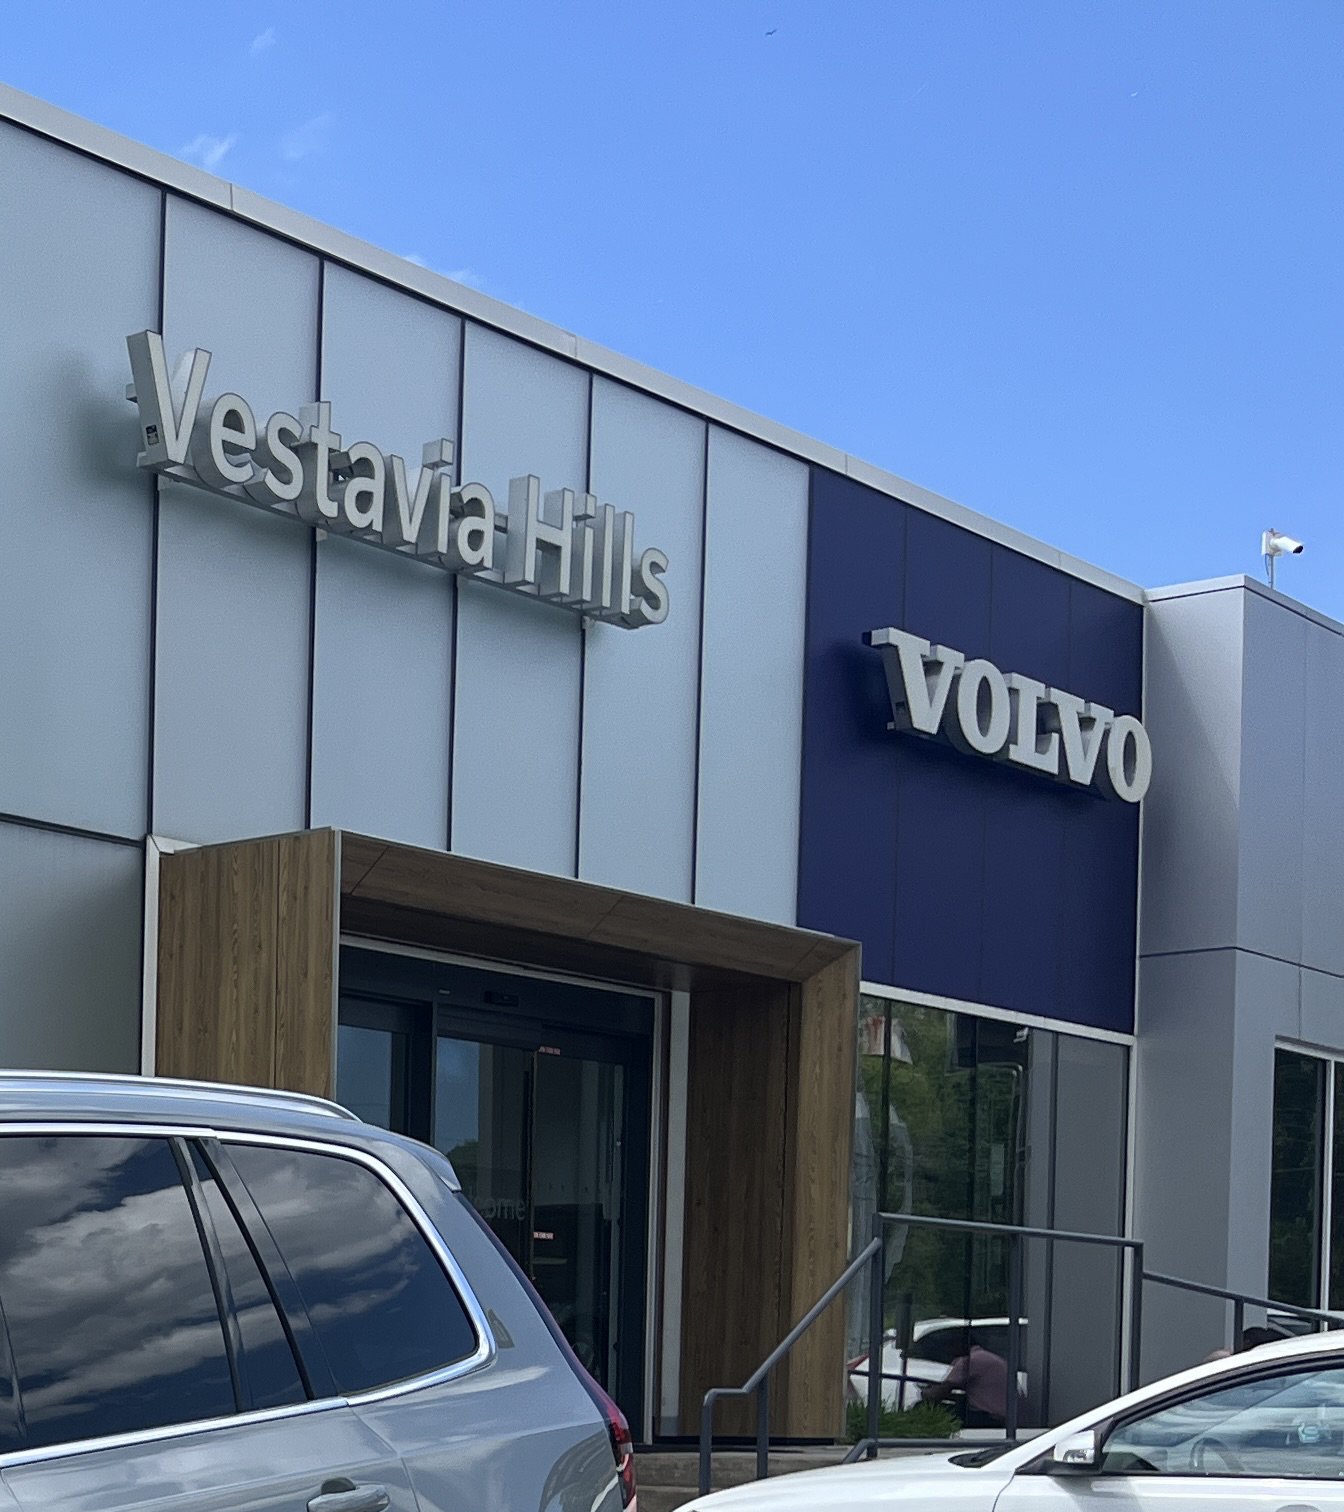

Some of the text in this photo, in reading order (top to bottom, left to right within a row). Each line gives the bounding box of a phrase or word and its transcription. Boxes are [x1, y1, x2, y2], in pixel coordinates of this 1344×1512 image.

[125, 330, 670, 628] Vestavia Hills
[871, 627, 1152, 803] VOLVO
